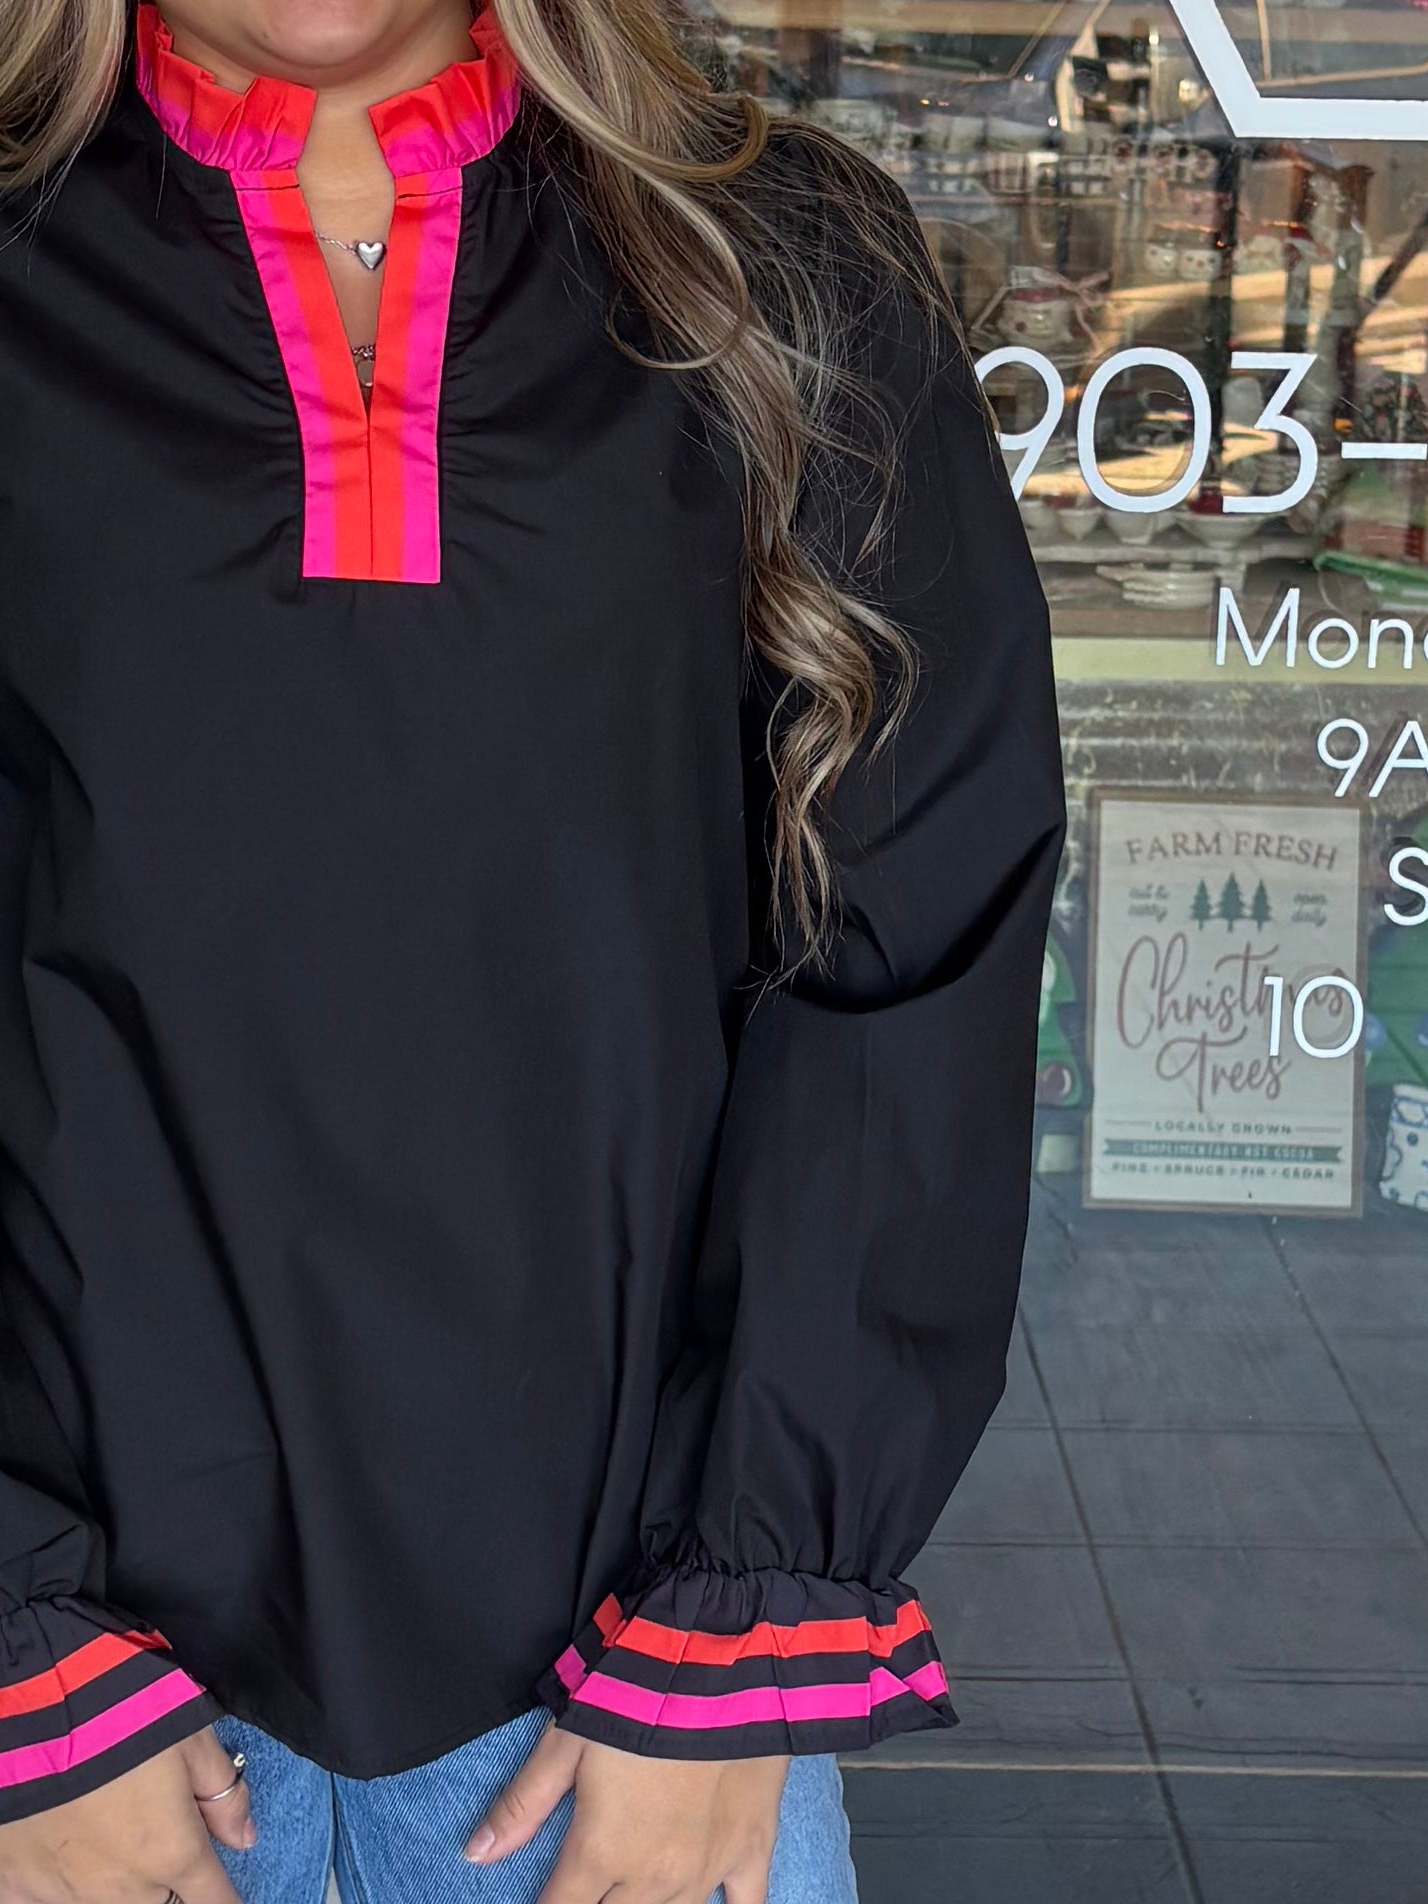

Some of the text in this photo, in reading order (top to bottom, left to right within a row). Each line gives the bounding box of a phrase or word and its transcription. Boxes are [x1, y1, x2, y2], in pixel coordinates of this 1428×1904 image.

[1126, 830, 1338, 871] FARM FRESH
[1155, 1026, 1292, 1115] Trees
[1154, 1122, 1224, 1134] LOCALLY
